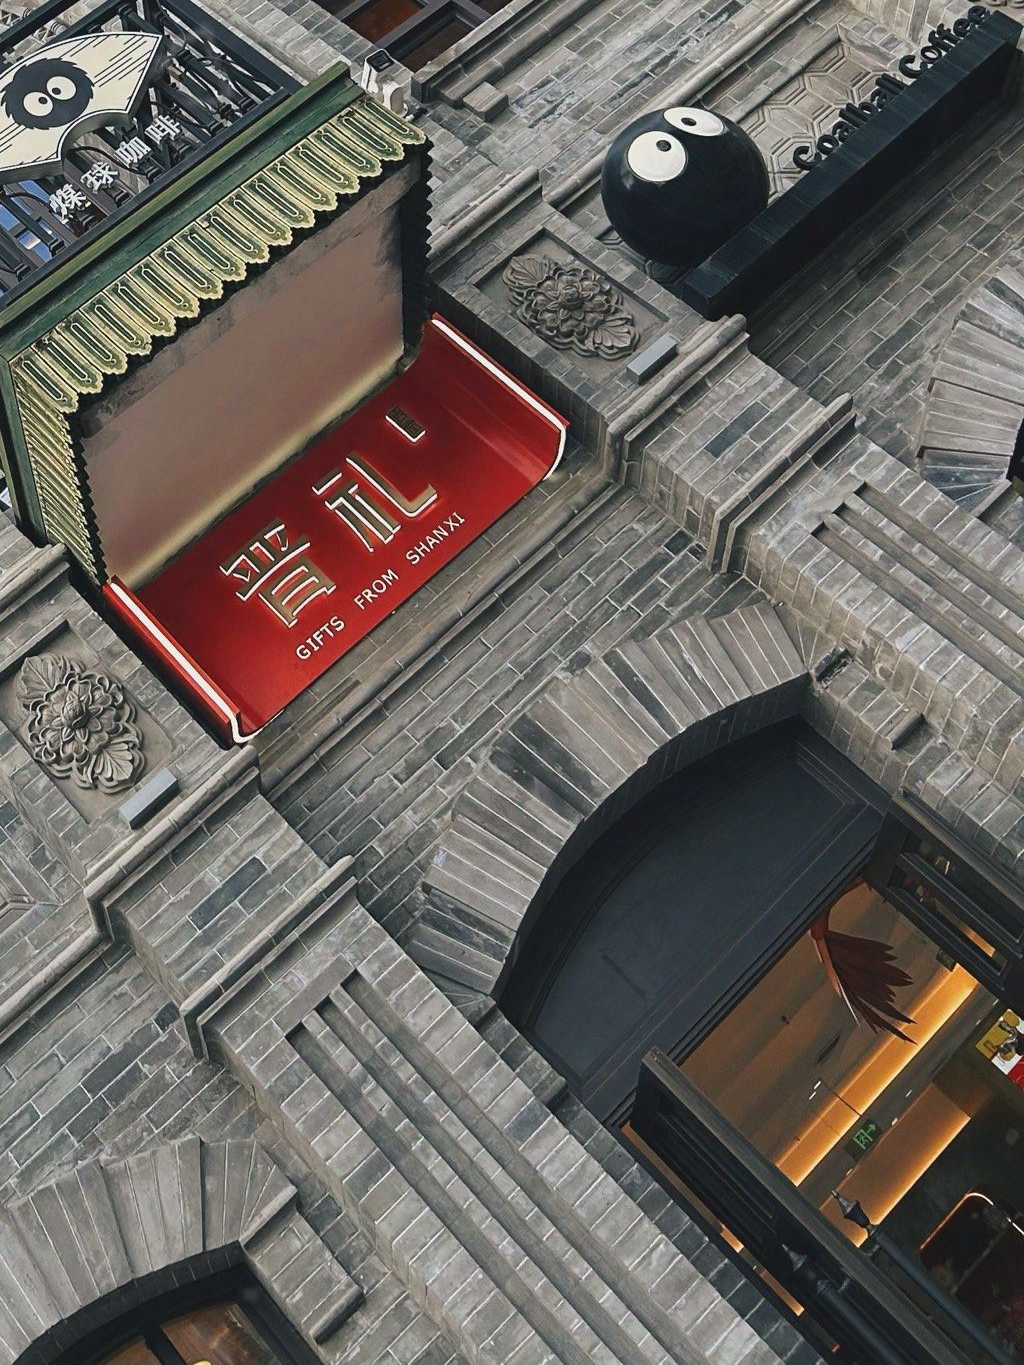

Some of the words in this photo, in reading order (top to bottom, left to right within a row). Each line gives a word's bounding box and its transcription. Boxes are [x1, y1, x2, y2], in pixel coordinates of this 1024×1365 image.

[48, 114, 182, 220] 煤球咖啡
[792, 72, 911, 171] Coalball
[898, 4, 991, 79] Coffee
[219, 450, 439, 628] 晋礼
[295, 615, 346, 661] GIFTS
[353, 568, 400, 611] FROM
[405, 510, 466, 566] SHANXI
